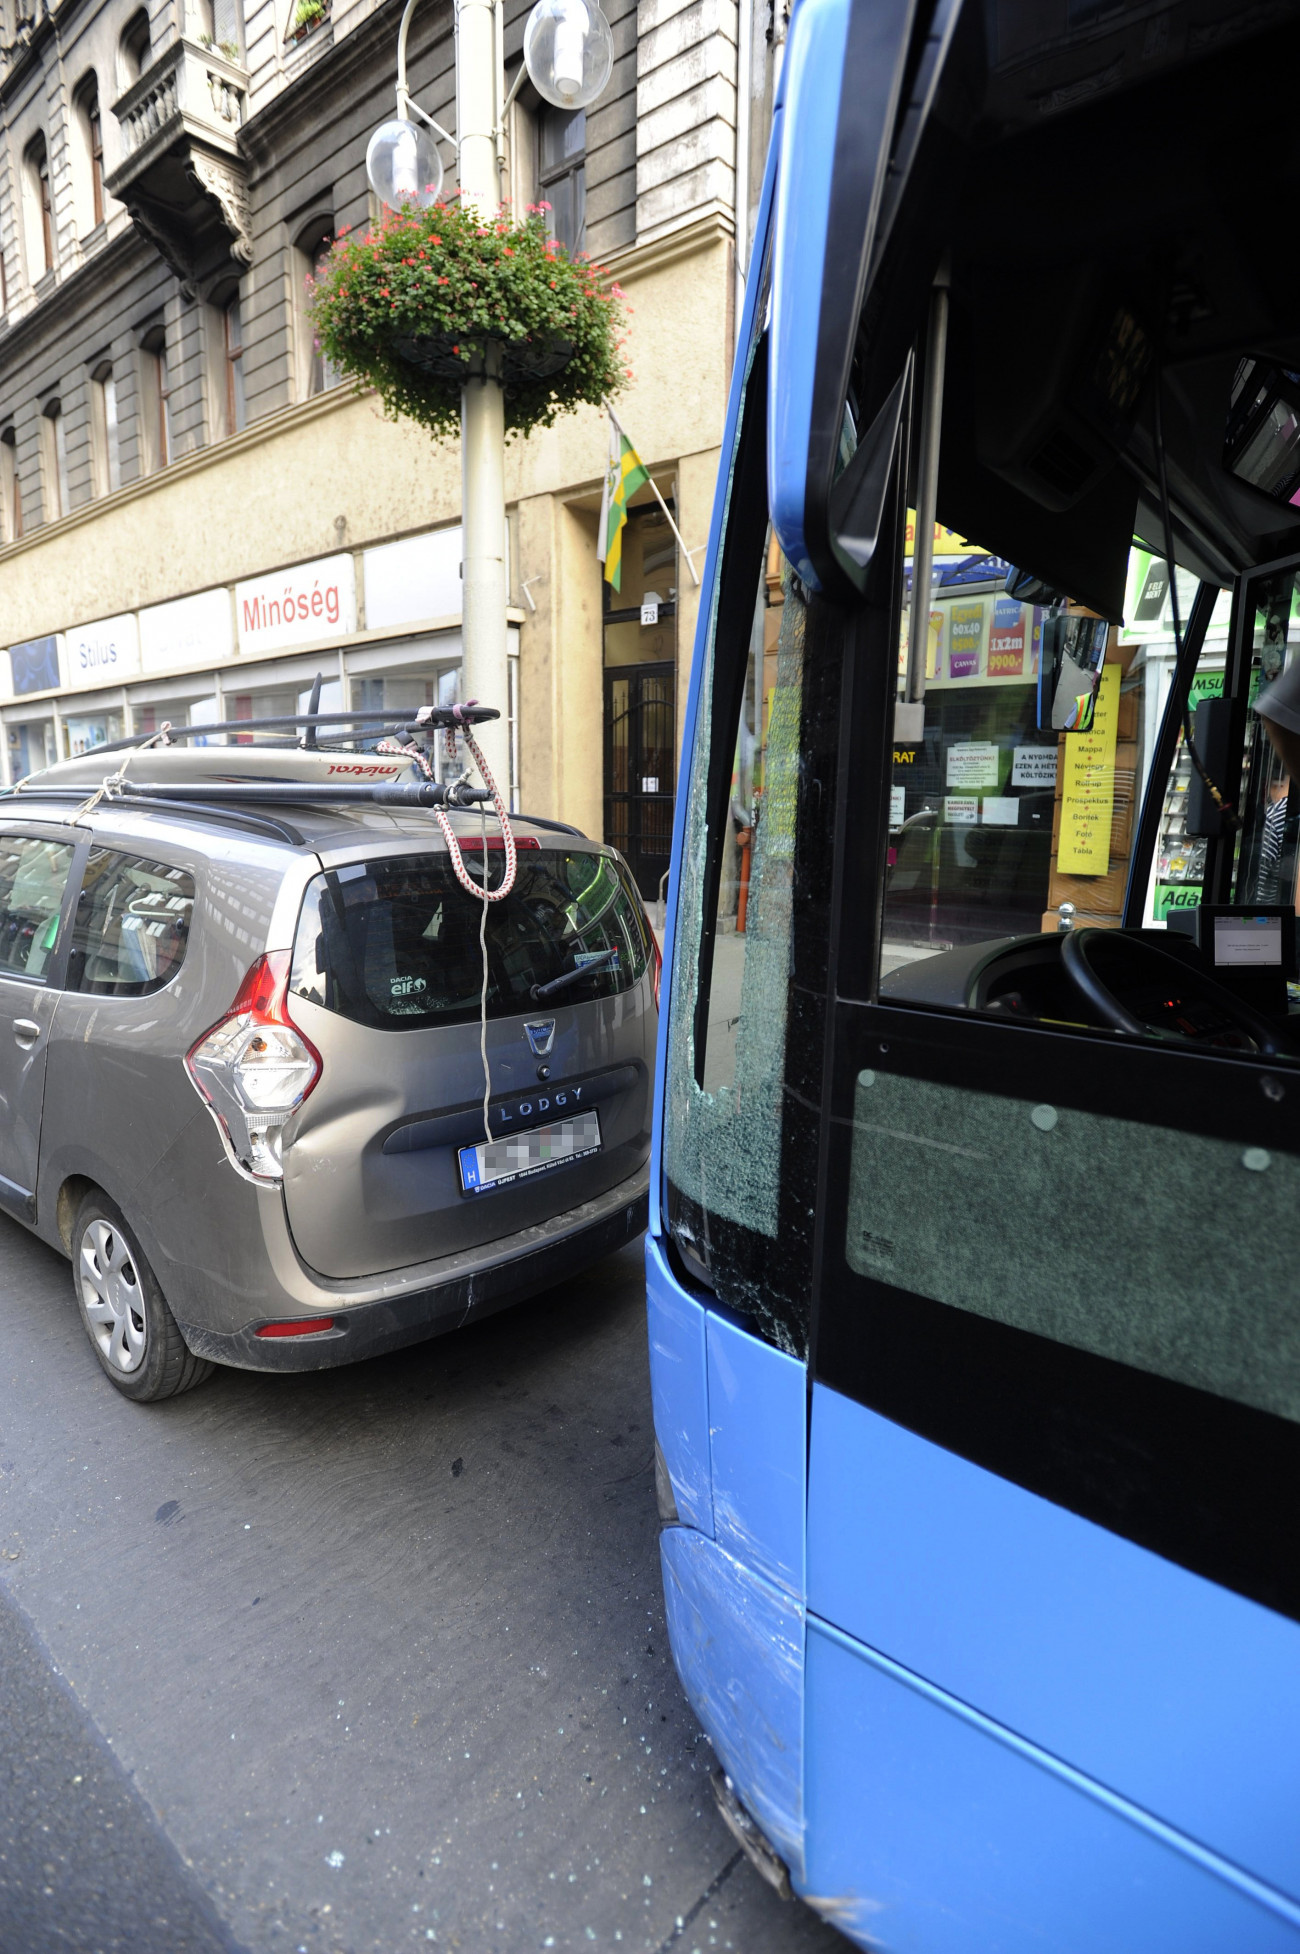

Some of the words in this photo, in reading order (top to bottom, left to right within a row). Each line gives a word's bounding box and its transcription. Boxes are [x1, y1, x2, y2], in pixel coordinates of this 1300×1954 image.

[243, 580, 339, 632] Minőség
[643, 610, 656, 622] 73
[990, 637, 1023, 651] 1x2m
[79, 640, 117, 668] Stilus
[327, 765, 398, 776] mistral
[1162, 891, 1199, 906] Adá
[390, 976, 413, 984] DACIA
[391, 981, 413, 995] elf
[501, 1087, 581, 1121] LODGY
[467, 1170, 476, 1183] H
